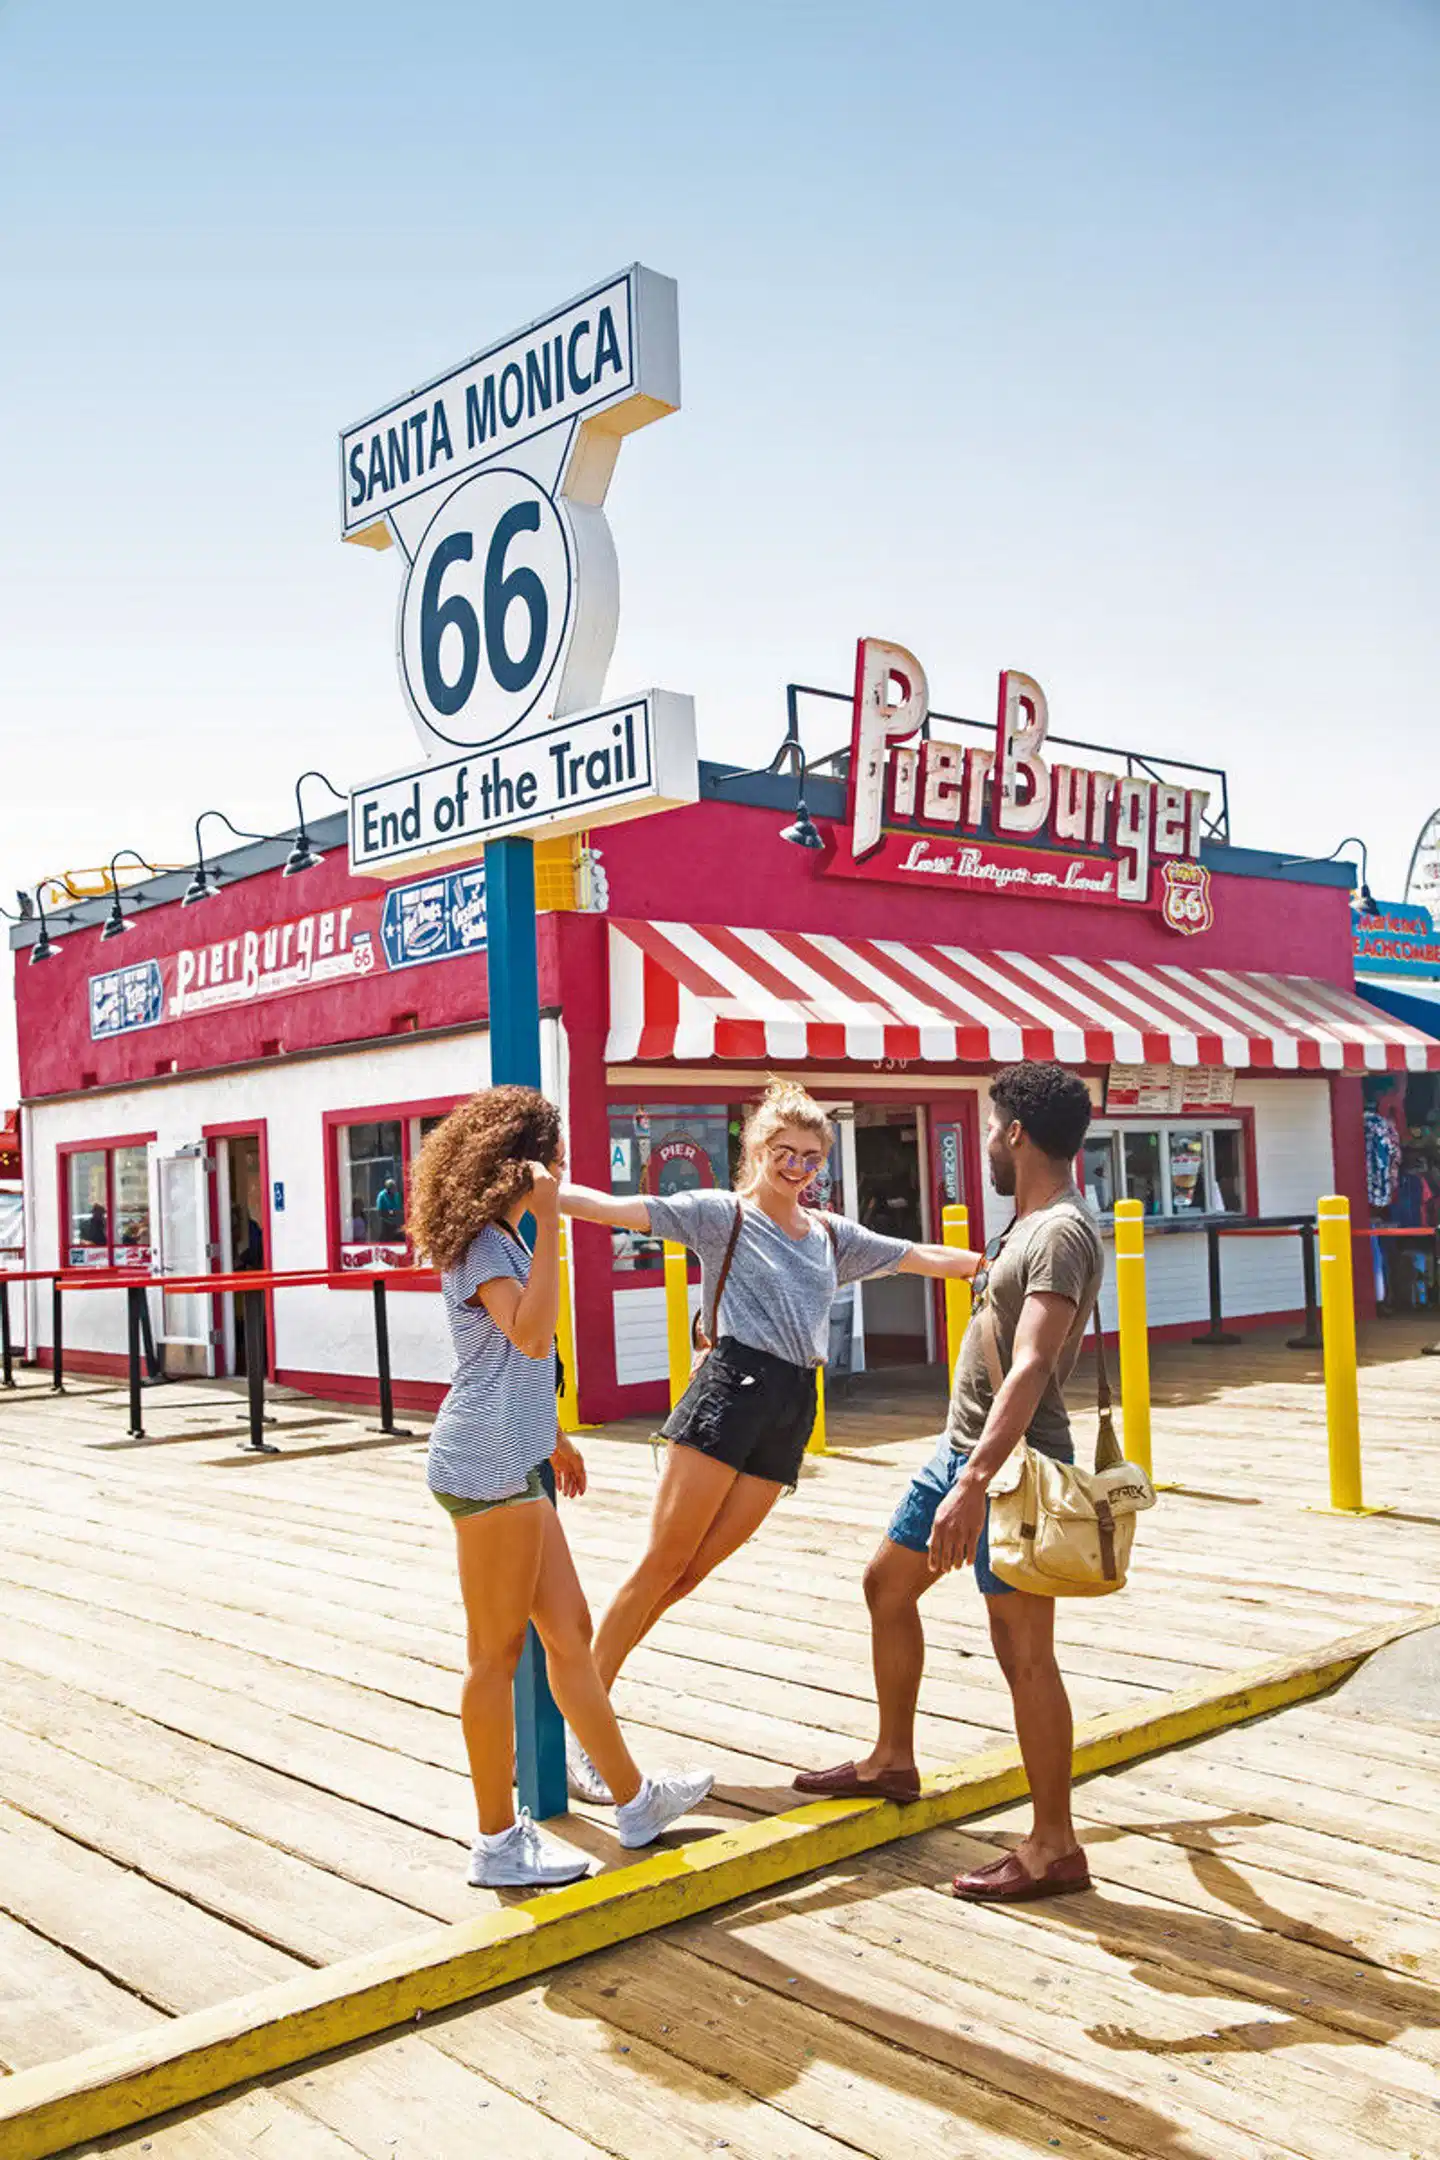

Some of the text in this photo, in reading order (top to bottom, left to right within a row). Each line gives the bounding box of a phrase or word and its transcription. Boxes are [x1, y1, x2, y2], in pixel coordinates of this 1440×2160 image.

[350, 305, 624, 507] SANTA MONICA
[420, 500, 549, 716] 66
[363, 714, 637, 853] End of the Trail
[1168, 888, 1203, 922] 66
[353, 946, 373, 968] 66
[612, 1145, 626, 1168] A
[660, 1143, 697, 1162] PIER
[943, 1135, 957, 1199] CONES
